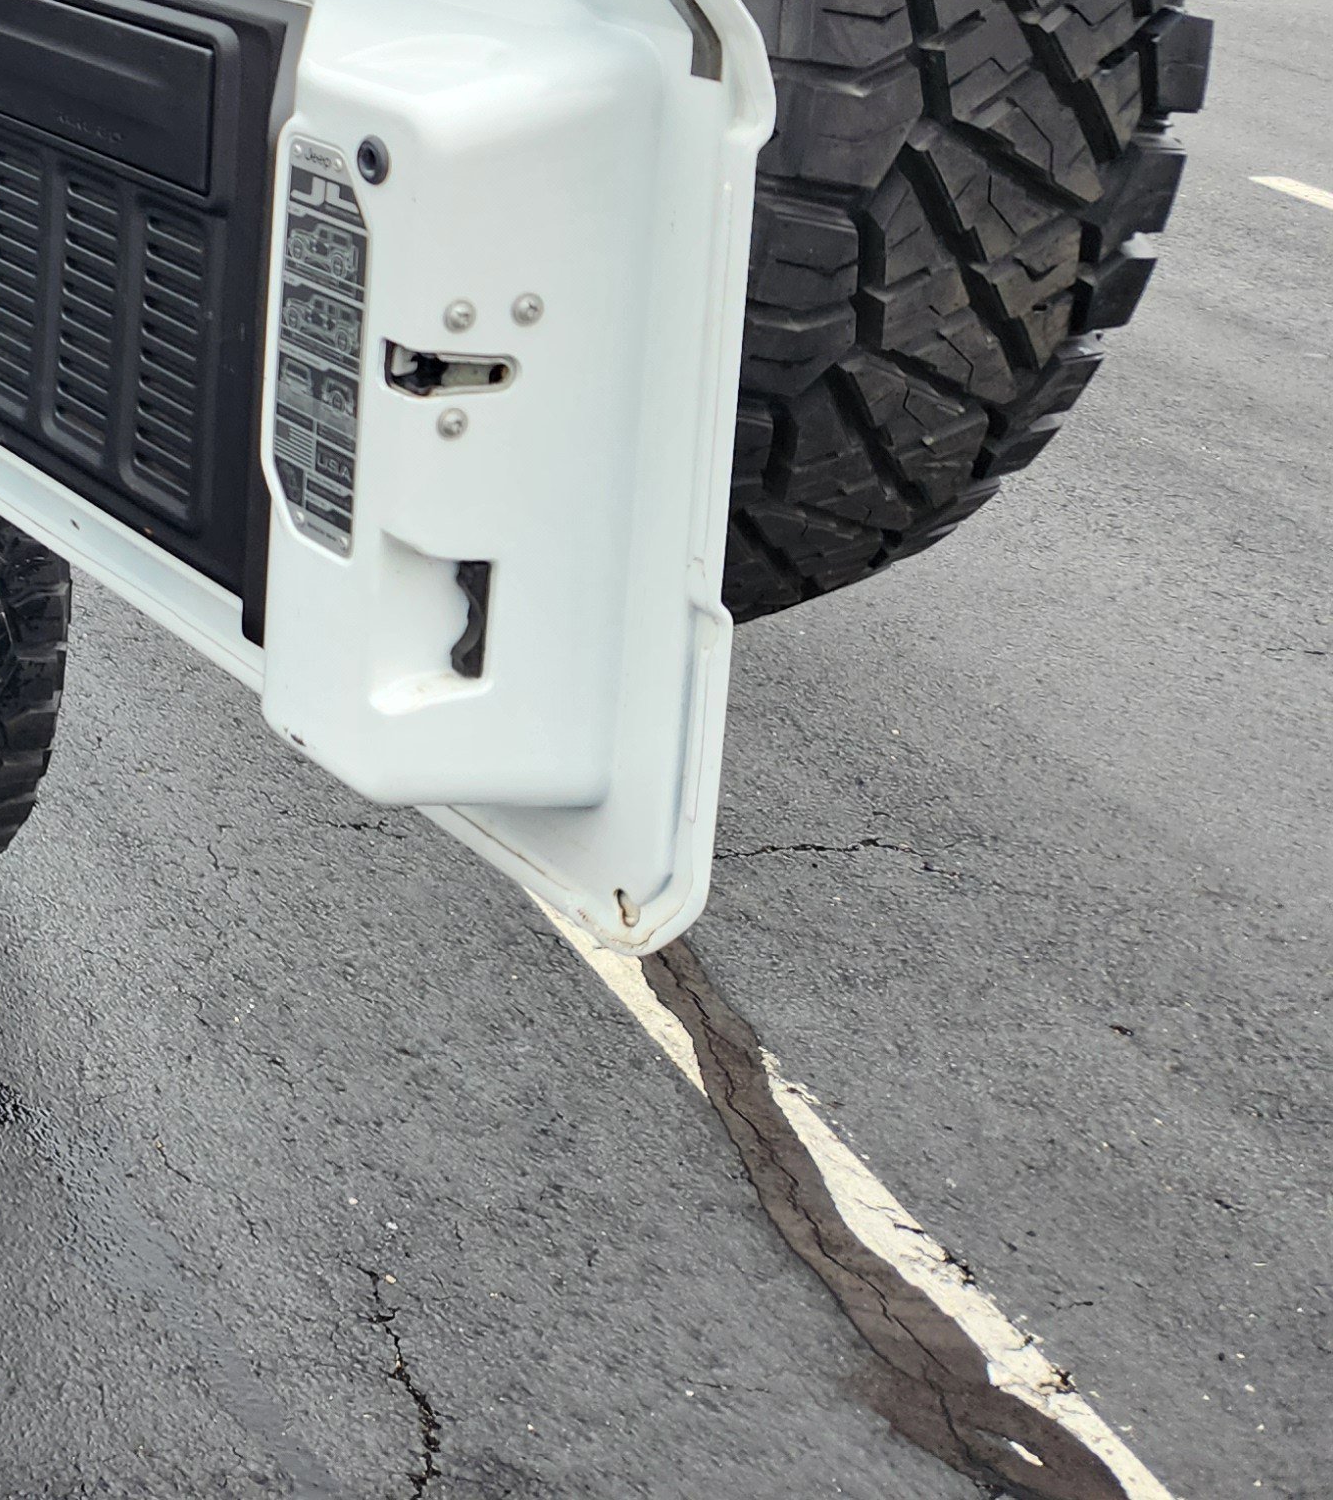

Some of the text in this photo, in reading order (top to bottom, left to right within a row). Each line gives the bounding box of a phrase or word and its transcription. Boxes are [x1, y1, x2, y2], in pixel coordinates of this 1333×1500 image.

[304, 147, 332, 170] Jeep
[290, 176, 361, 215] JL
[316, 452, 352, 482] USA
